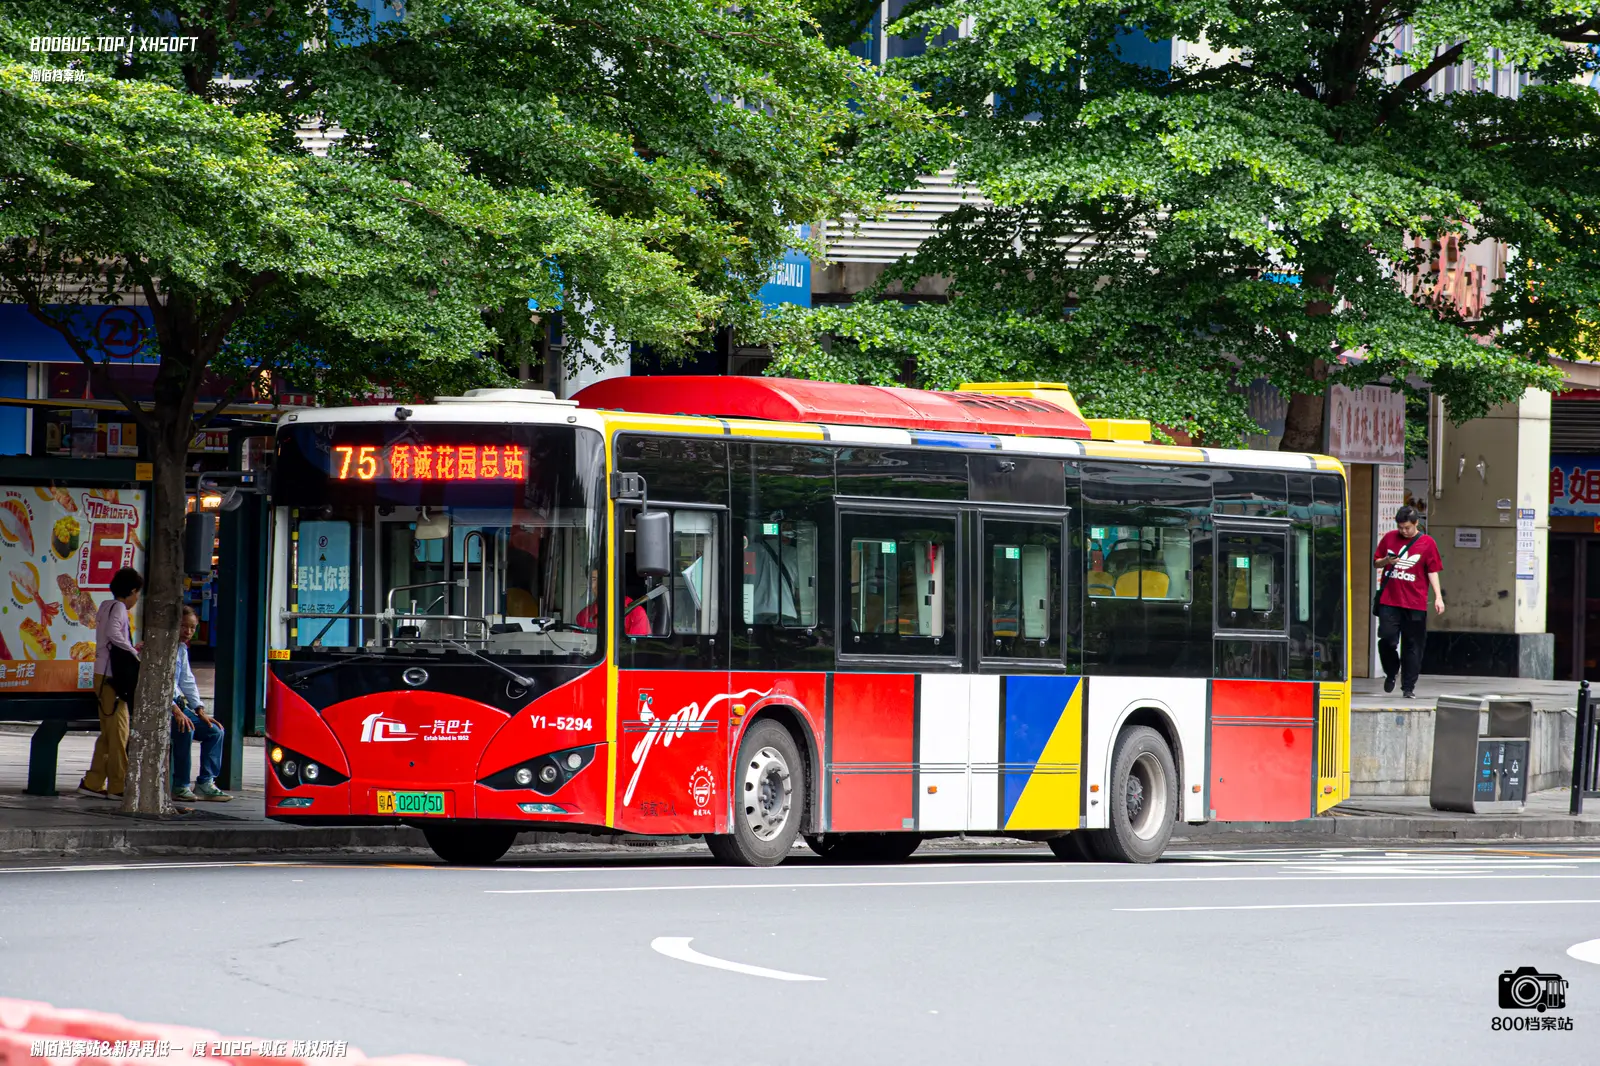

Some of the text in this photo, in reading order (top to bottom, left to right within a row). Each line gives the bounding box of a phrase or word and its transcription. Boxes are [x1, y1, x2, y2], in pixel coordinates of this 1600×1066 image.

[336, 445, 525, 480] 75 侨诚花园总站
[419, 719, 473, 734] 一汽巴士
[530, 714, 593, 732] Y1-5294
